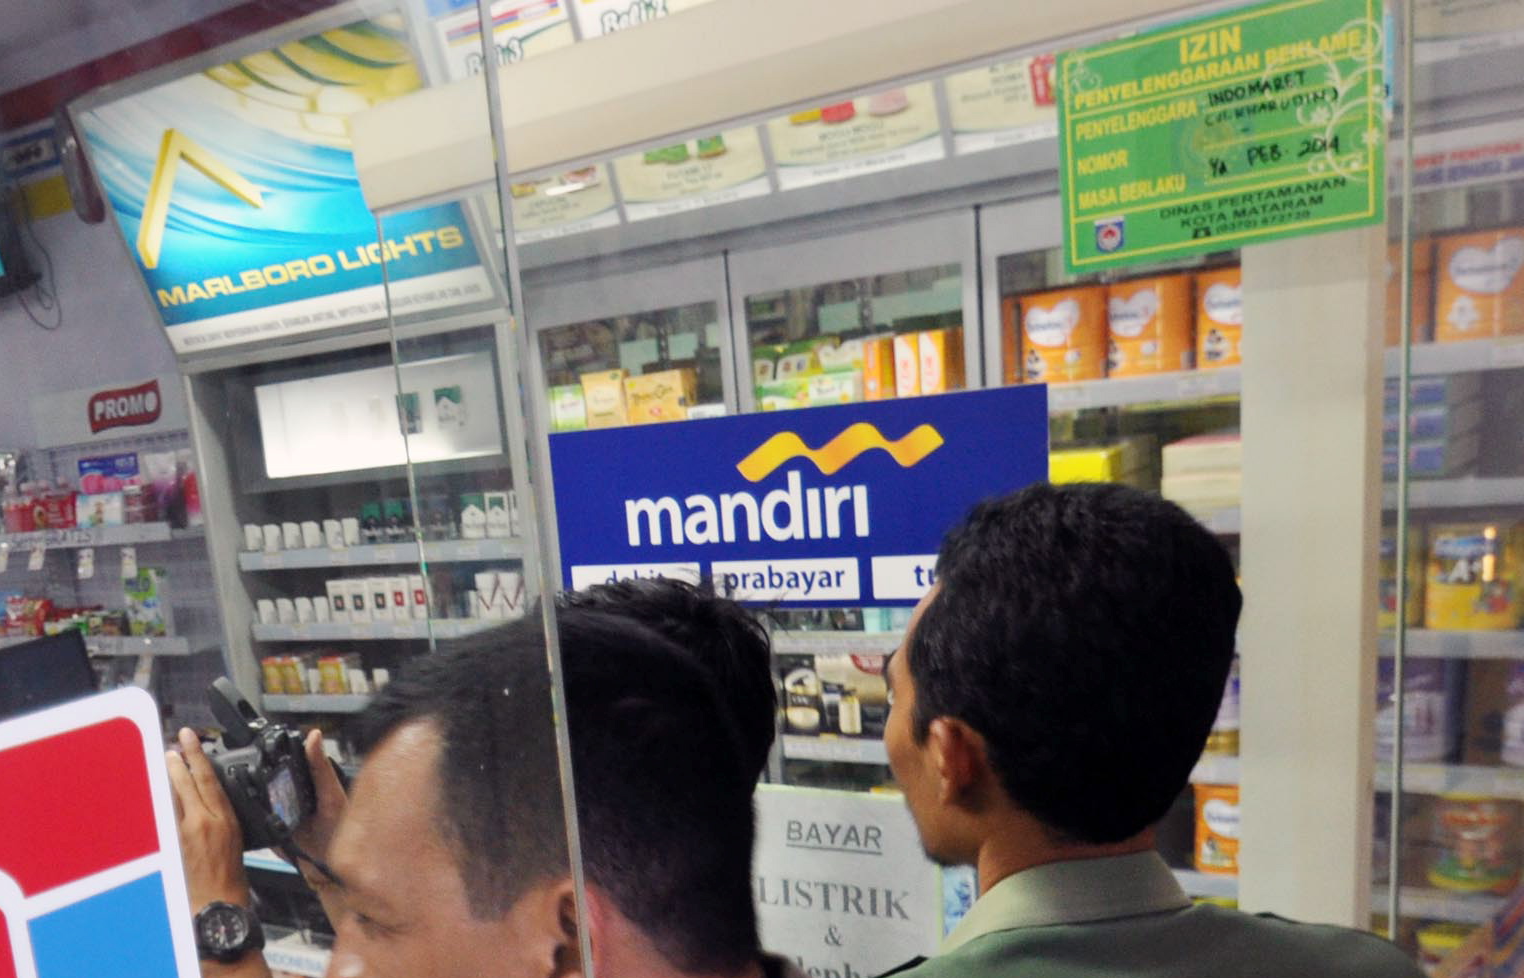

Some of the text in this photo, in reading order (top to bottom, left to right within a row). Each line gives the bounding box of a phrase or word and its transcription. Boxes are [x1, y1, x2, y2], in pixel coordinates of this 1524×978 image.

[1179, 26, 1242, 65] IZIN
[1075, 52, 1261, 110] PENYELENGGARAAN
[1265, 30, 1363, 66] REKLAME
[1208, 70, 1306, 107] INDOMARET
[1076, 98, 1198, 141] PENYELENGGARA
[1077, 149, 1128, 176] NOMOR
[1078, 173, 1187, 210] MASA BERLAKU
[1159, 177, 1347, 219] DINAS PERTAMANAN
[1180, 195, 1325, 229] KOTA MATARAM
[157, 225, 464, 308] MARLBORO LIGHTS
[93, 391, 158, 422] PROMO
[625, 470, 869, 546] mandiri
[728, 565, 845, 595] prabayar
[786, 820, 882, 850] BAYAR
[757, 877, 910, 921] LISTRIK
[824, 926, 843, 948] &
